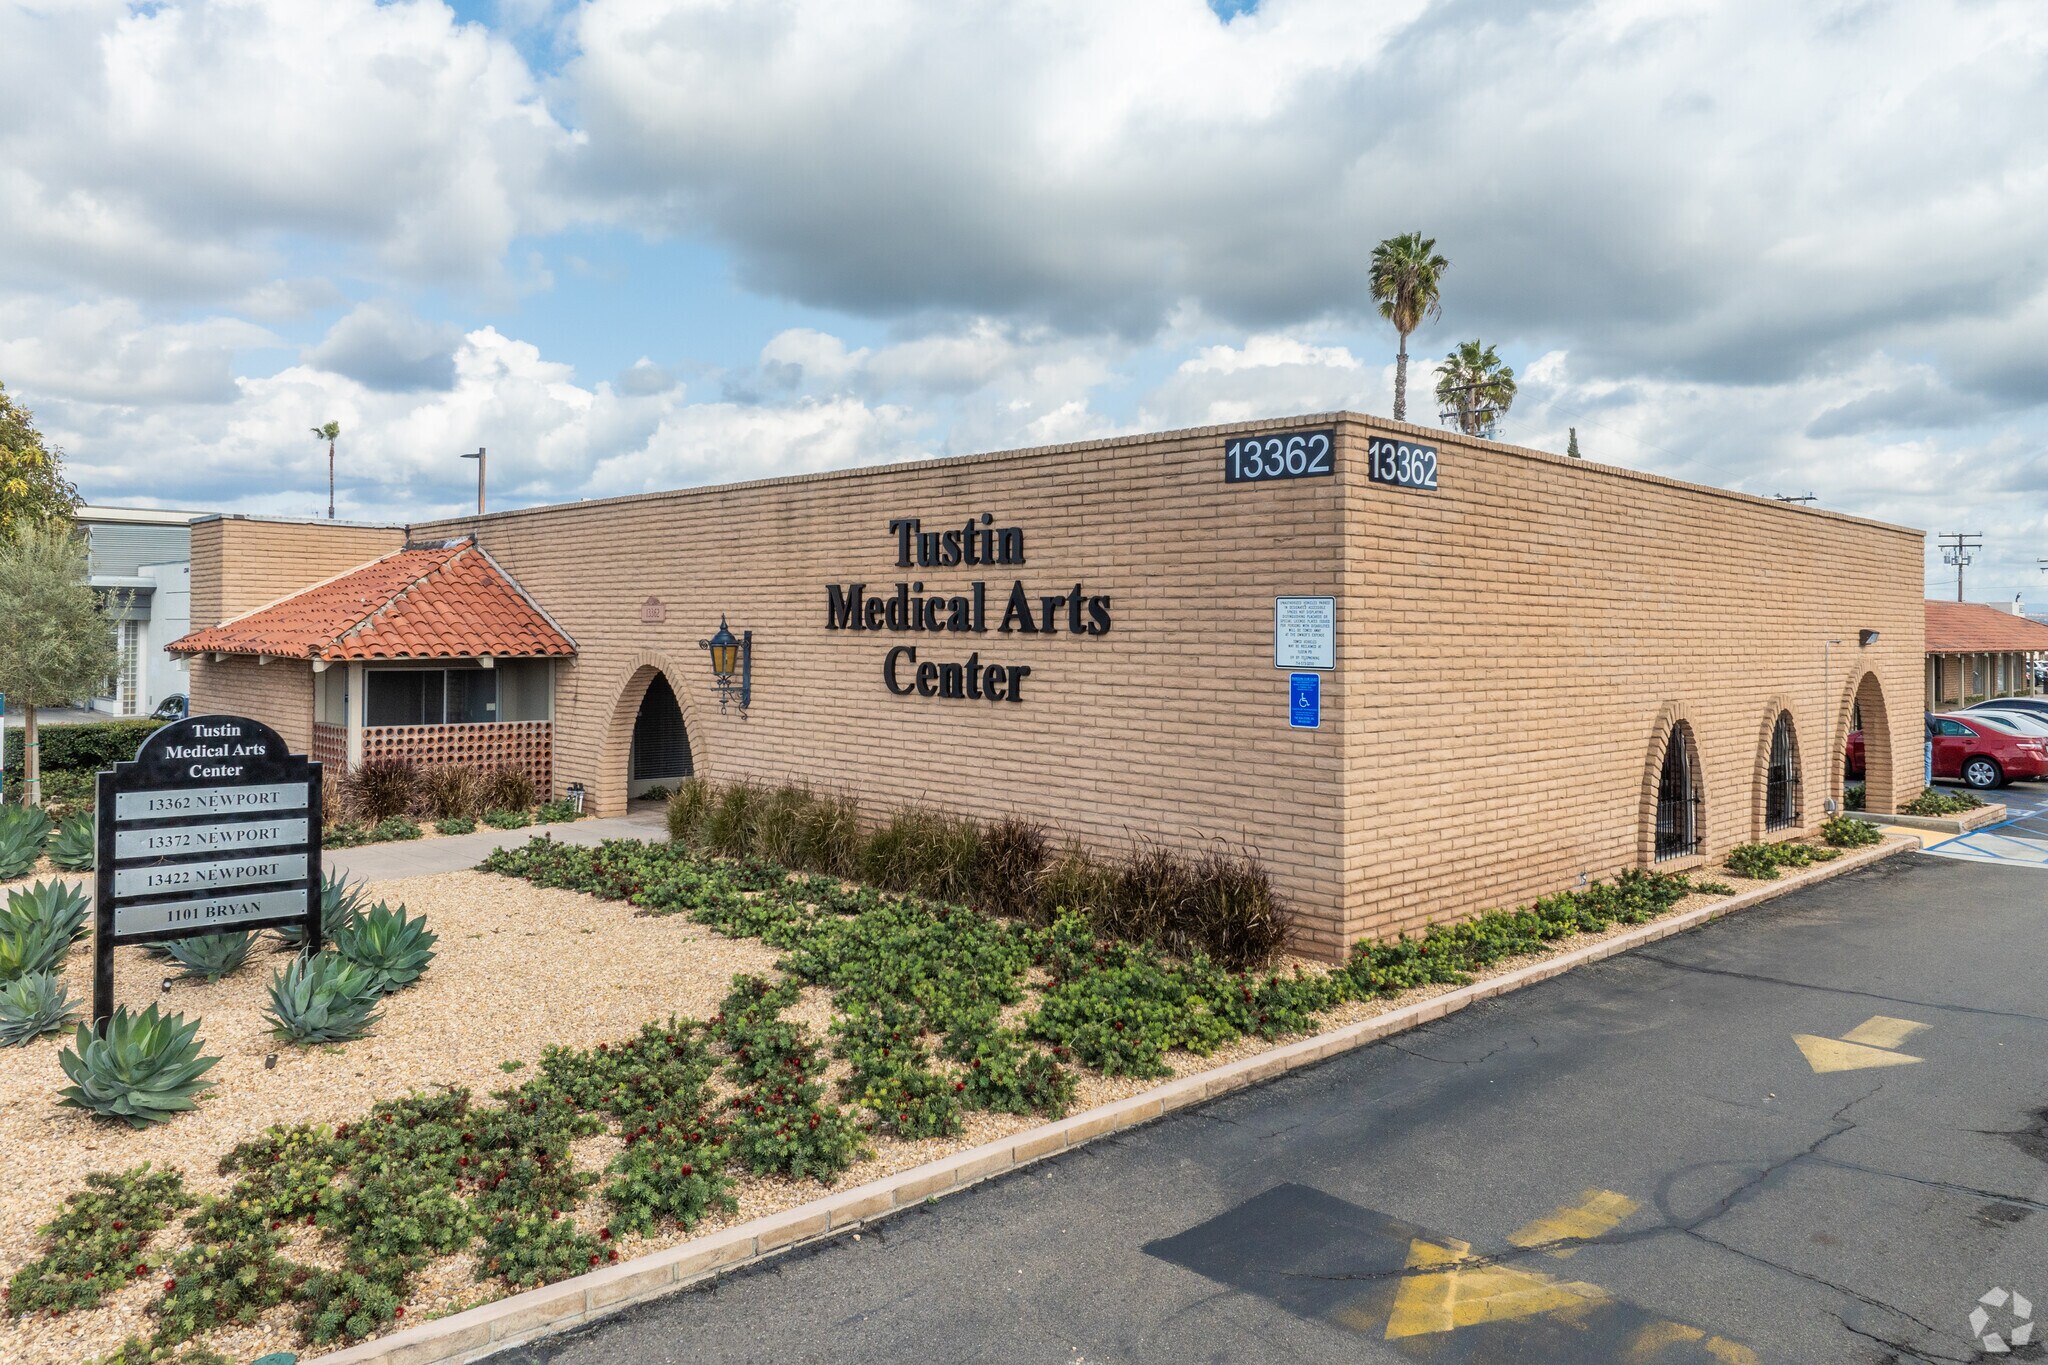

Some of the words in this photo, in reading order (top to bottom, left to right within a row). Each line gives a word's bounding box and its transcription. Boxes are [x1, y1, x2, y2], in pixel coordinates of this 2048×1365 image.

[1229, 434, 1330, 479] 13362
[1369, 441, 1438, 487] 13362
[889, 512, 1026, 567] Tustin
[825, 581, 988, 633] Medical
[998, 580, 1112, 635] Arts
[883, 645, 1031, 702] Center
[192, 723, 241, 738] Tustin
[165, 744, 229, 760] Medical
[232, 743, 266, 757] Arts
[189, 764, 244, 778] Center
[149, 797, 191, 811] 13362
[196, 791, 280, 808] NEWPORT
[149, 834, 191, 849] 13372
[196, 827, 280, 845] NEWPORT
[147, 872, 190, 887] 13422
[196, 863, 280, 882] NEWPORT
[167, 908, 199, 922] 1101
[205, 901, 262, 918] BRYAN
